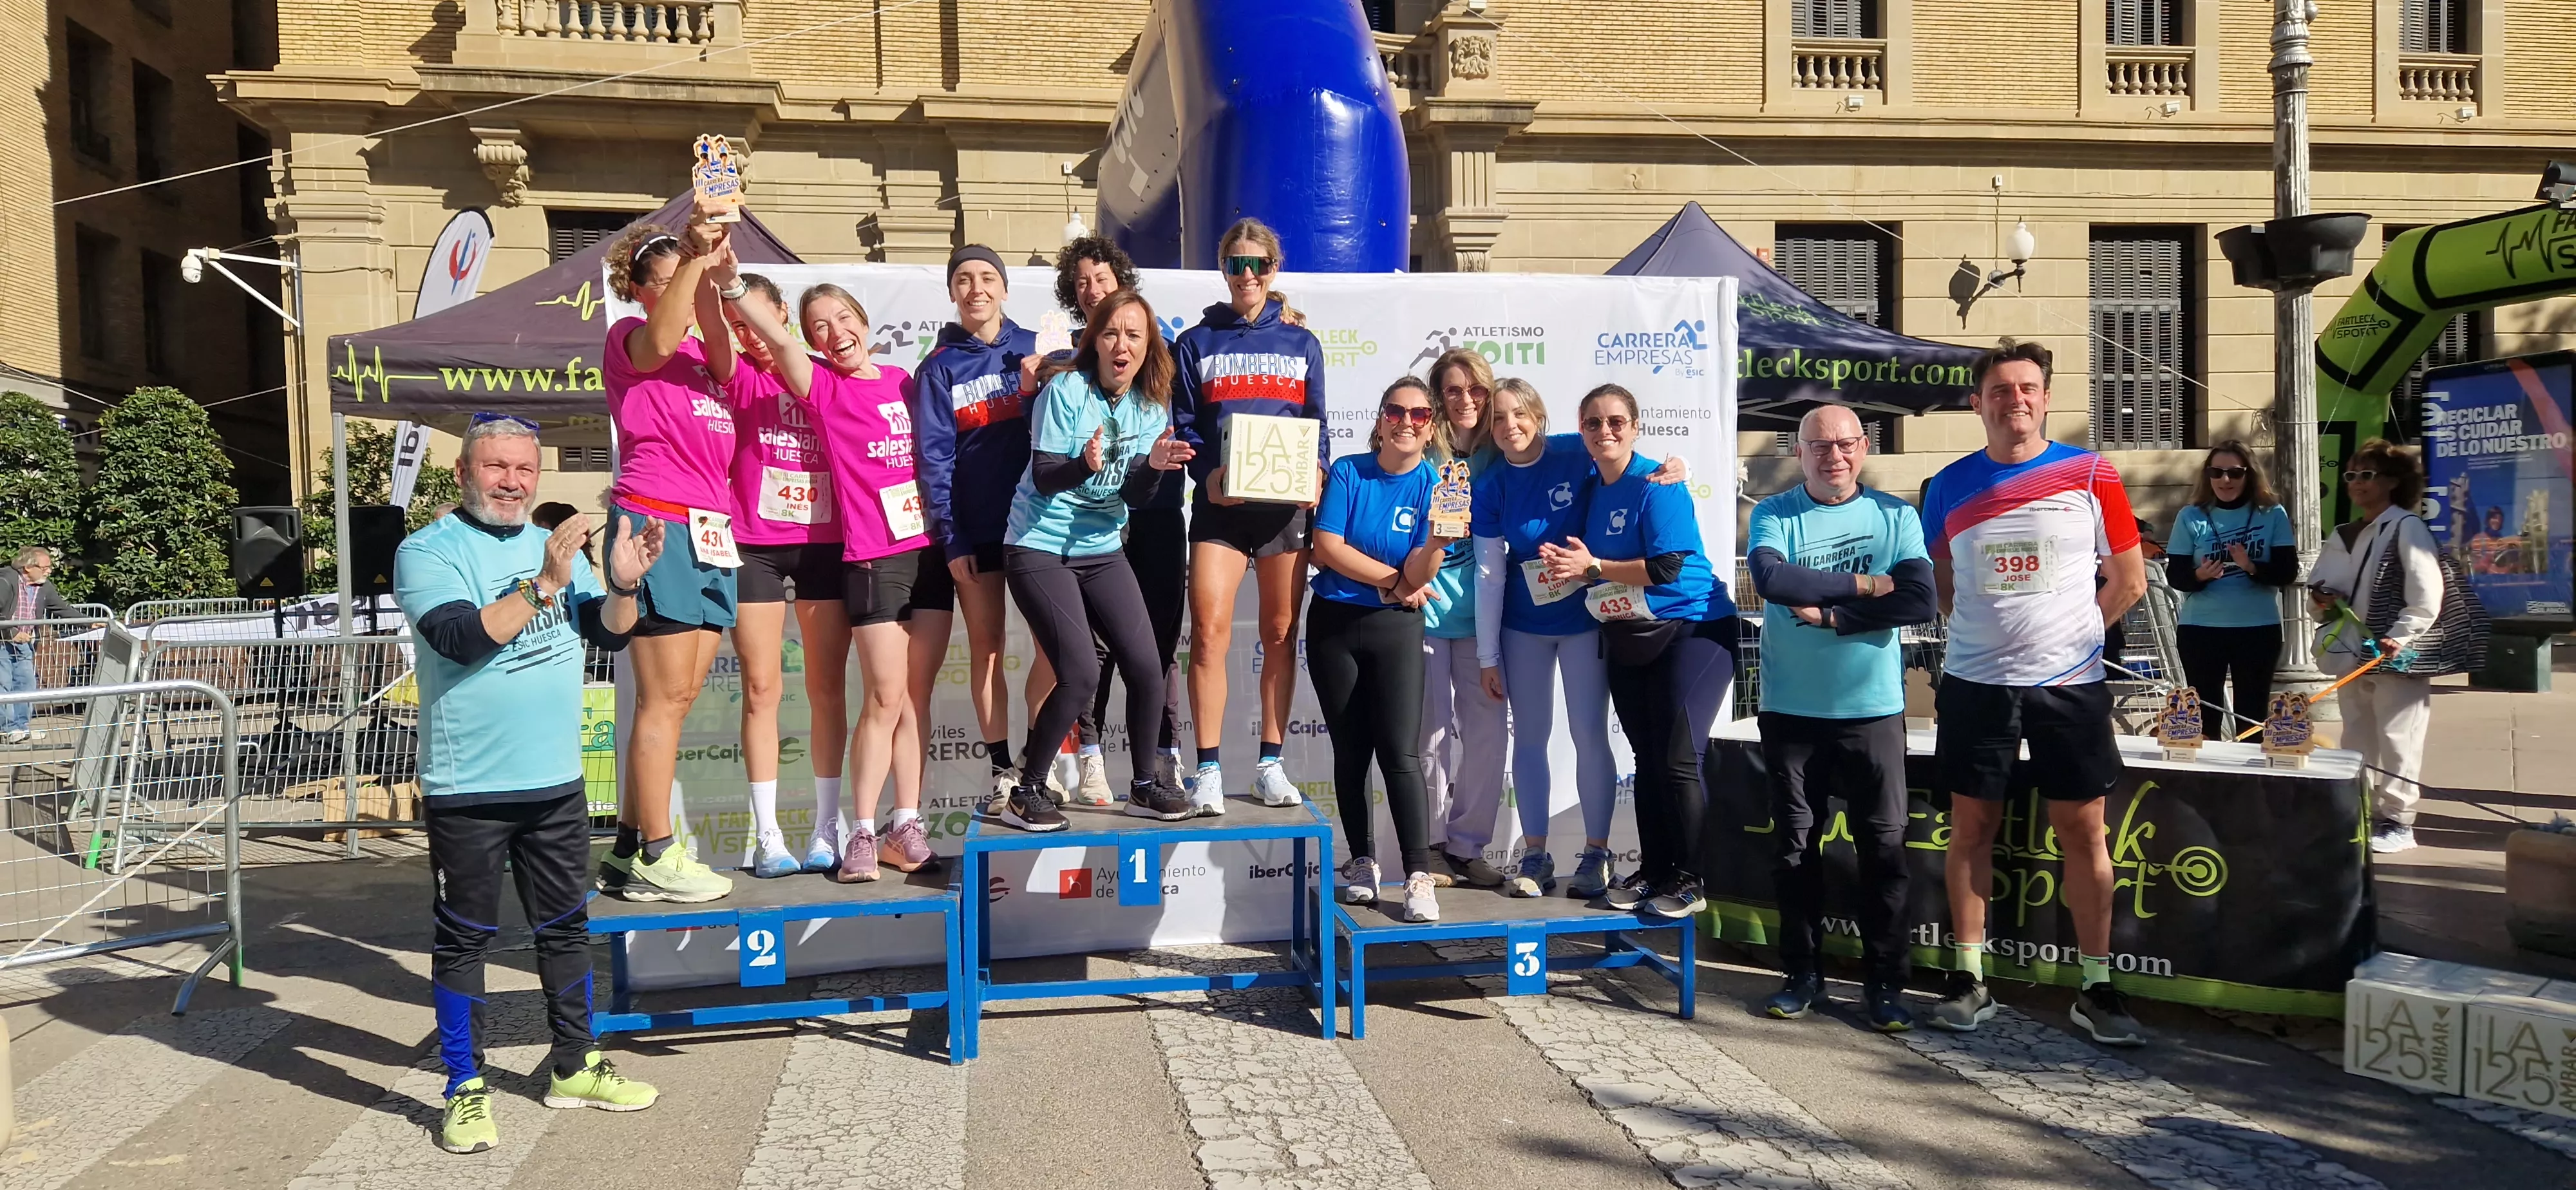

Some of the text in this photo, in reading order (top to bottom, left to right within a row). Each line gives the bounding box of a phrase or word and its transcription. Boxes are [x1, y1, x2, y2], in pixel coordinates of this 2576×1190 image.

[705, 178, 739, 195] EMPRESAS
[2337, 314, 2376, 326] FARTLECK
[1463, 326, 1544, 337] ATLETISMO
[2336, 326, 2378, 339] SPORT
[1597, 332, 1690, 348] CARRERA
[1213, 353, 1298, 378] BOMBEROS
[1595, 350, 1692, 366] EMPRESAS
[1675, 368, 1685, 378] By
[1213, 376, 1297, 390] HUESCA
[2458, 420, 2523, 440] CUIDAR
[2436, 432, 2568, 458] DE LO NUESTRO
[772, 448, 819, 465] HUESCA
[1236, 450, 1293, 495] 125
[1294, 438, 1310, 496] AMBAR
[777, 486, 819, 502] 430
[781, 509, 795, 518] 8K
[786, 502, 809, 511] INÉS
[1439, 500, 1470, 511] EMPRESAS
[910, 522, 922, 530] 8K
[1436, 523, 1443, 535] 3
[710, 549, 733, 558] ISABEL
[1813, 545, 1856, 567] CARRERA
[1994, 555, 2040, 573] 398
[1548, 578, 1571, 591] LIDIA
[2003, 574, 2031, 582] JOSE
[1548, 590, 1562, 599] 8K
[1599, 596, 1633, 615] 433
[531, 628, 562, 647] HUESCA
[2168, 726, 2201, 737] EMPRESAS
[2165, 750, 2170, 760] 1
[2268, 757, 2273, 768] 1
[1130, 848, 1148, 883] 1
[1096, 885, 1114, 898] de
[746, 930, 777, 967] 2
[1514, 941, 1540, 976] 3
[2352, 1023, 2429, 1081] 125
[2431, 1021, 2450, 1086] AMBAR
[2474, 1047, 2557, 1107] 125
[2558, 1044, 2576, 1113] AMBAR
